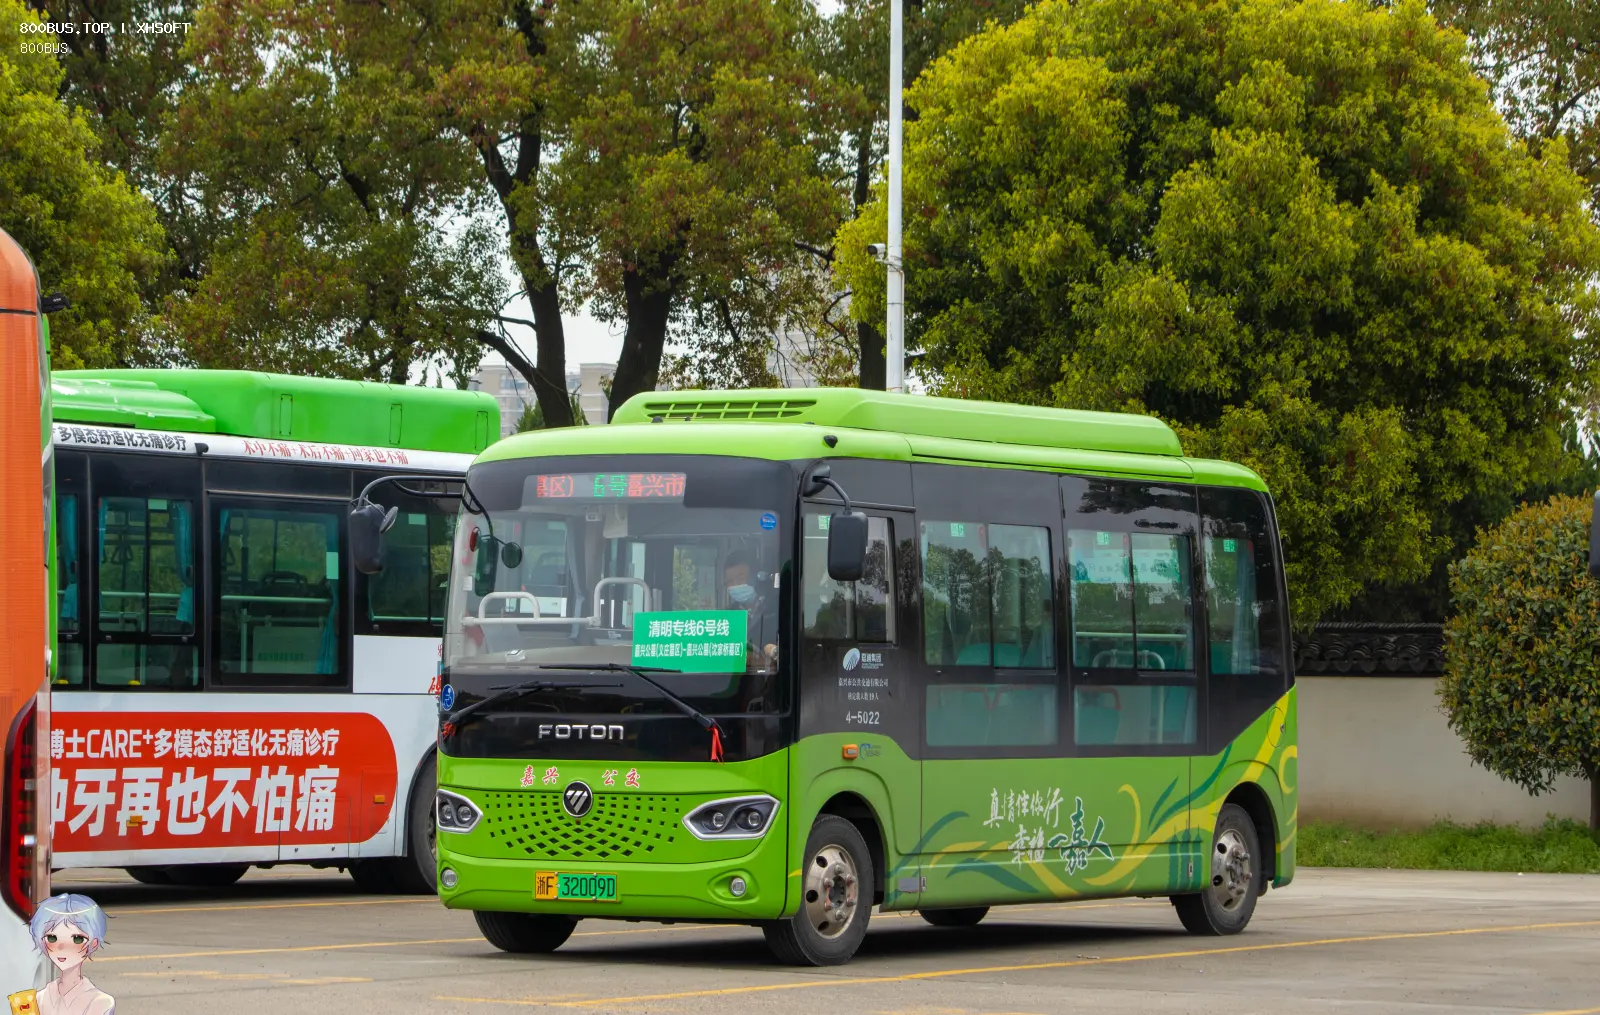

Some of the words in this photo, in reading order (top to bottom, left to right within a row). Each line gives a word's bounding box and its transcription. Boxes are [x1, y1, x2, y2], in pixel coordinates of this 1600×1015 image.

[648, 619, 730, 638] 清明专线6号线
[845, 710, 881, 725] 4-5022
[538, 724, 625, 740] FOTON
[520, 764, 560, 788] 嘉兴
[601, 767, 641, 789] 公交
[536, 875, 555, 896] 浙F
[561, 876, 616, 897] 32009D
